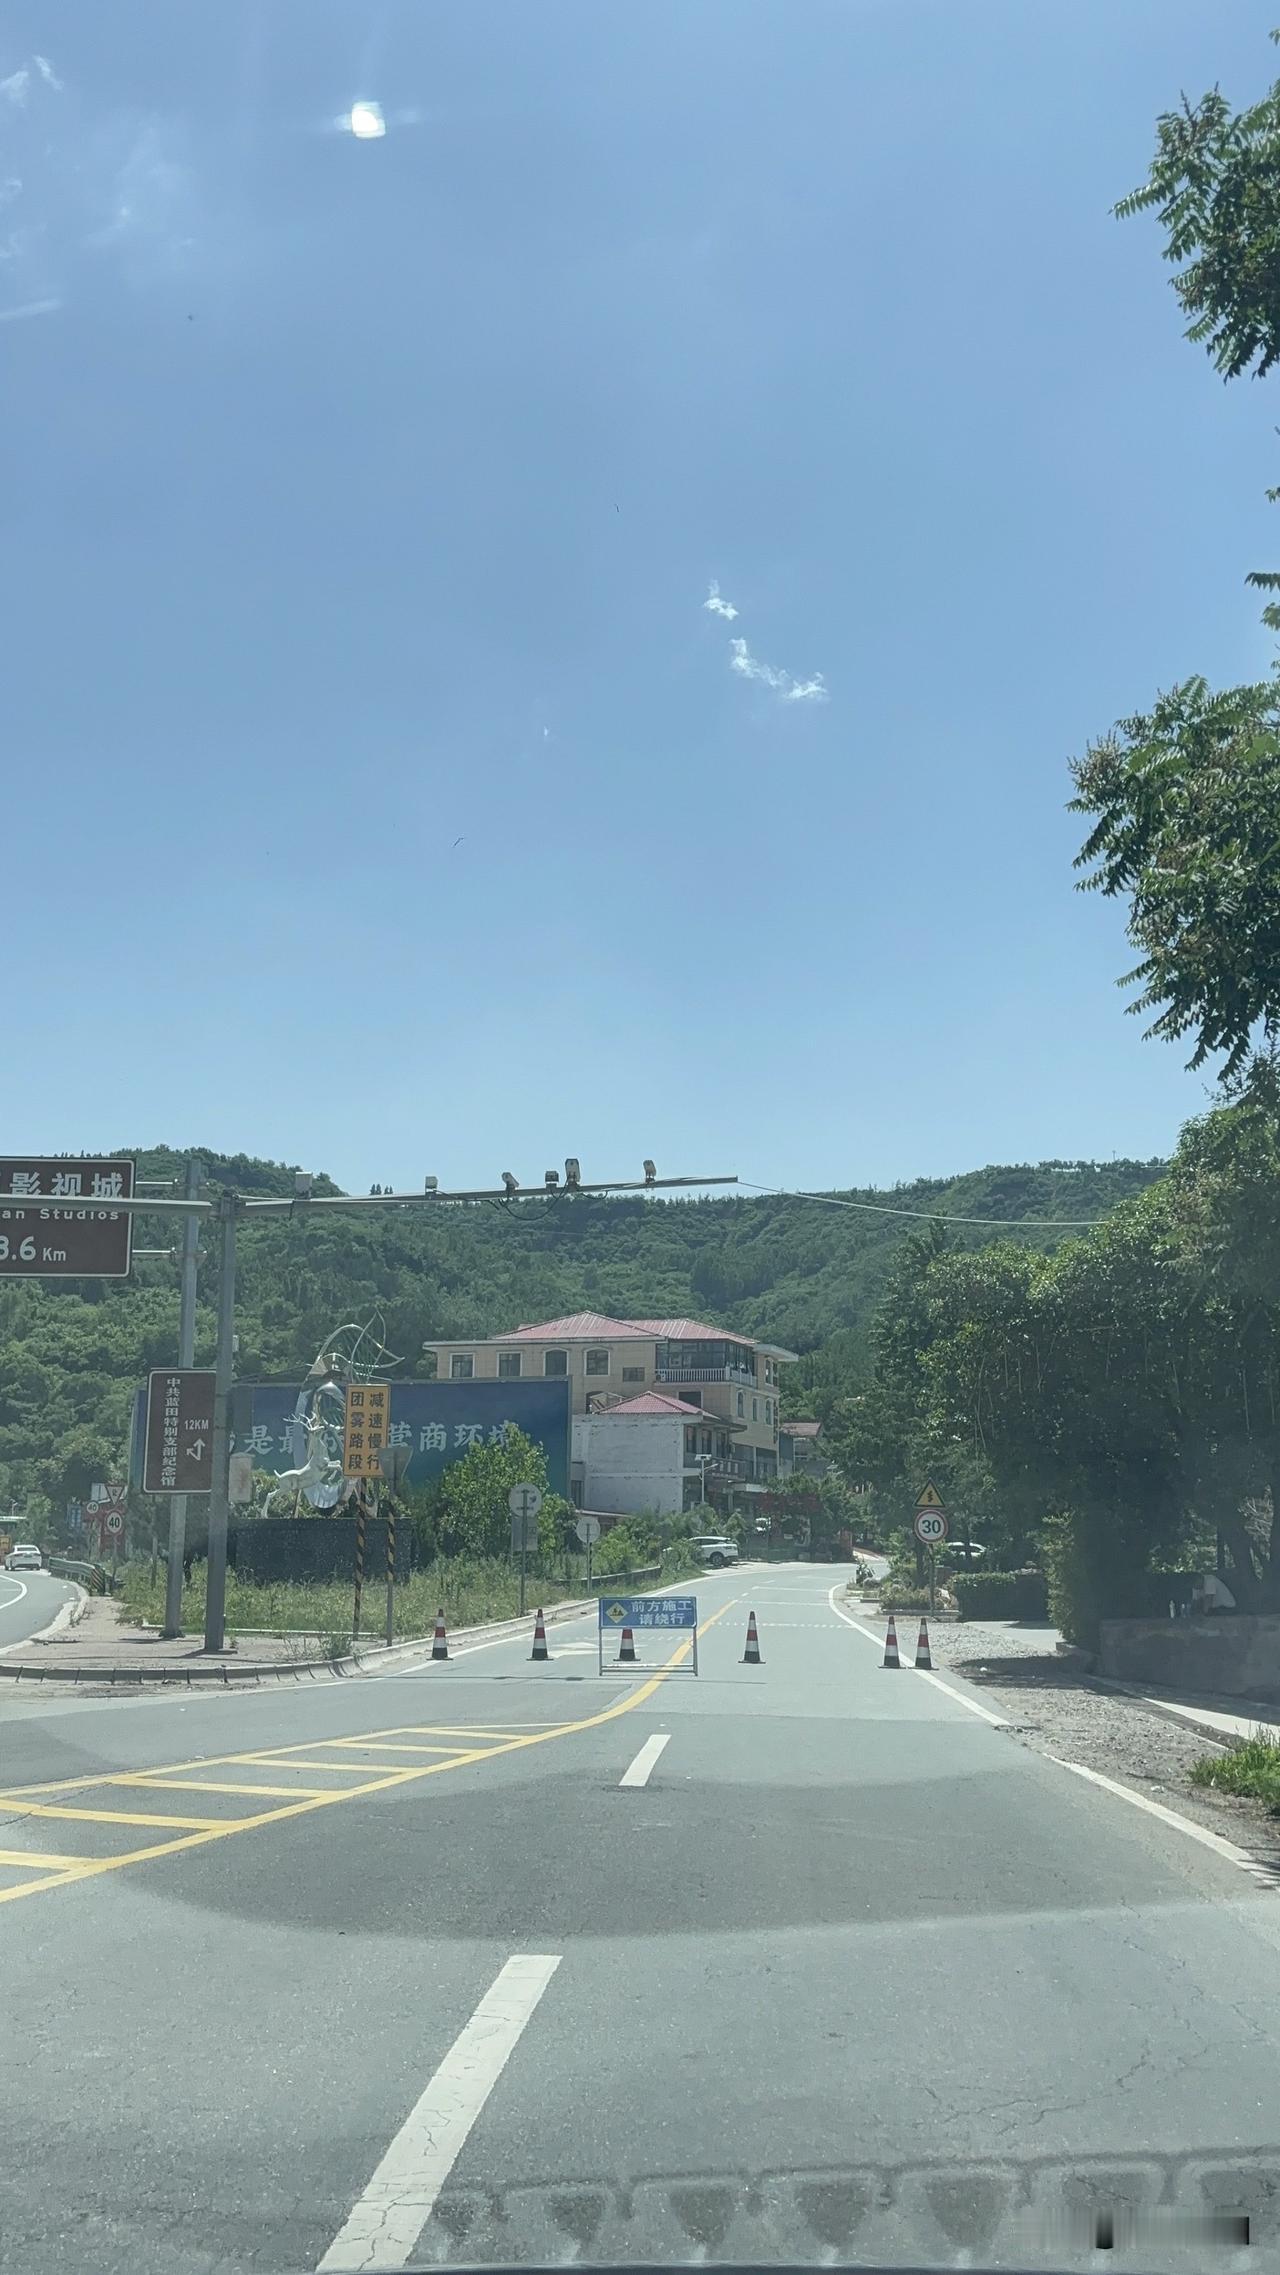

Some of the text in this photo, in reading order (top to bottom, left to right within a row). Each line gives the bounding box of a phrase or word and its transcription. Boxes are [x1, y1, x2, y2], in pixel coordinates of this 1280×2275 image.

[0, 1171, 123, 1199] 影视城
[40, 1208, 119, 1220] Studios
[42, 1247, 67, 1261] Km
[184, 1419, 209, 1430] 12KM
[348, 1391, 364, 1470] 团雾路段
[367, 1391, 384, 1470] 减速慢行
[109, 1516, 120, 1528] 40
[922, 1519, 941, 1534] 30
[632, 1600, 692, 1612] 前方施工
[640, 1613, 685, 1624] 请绕行
